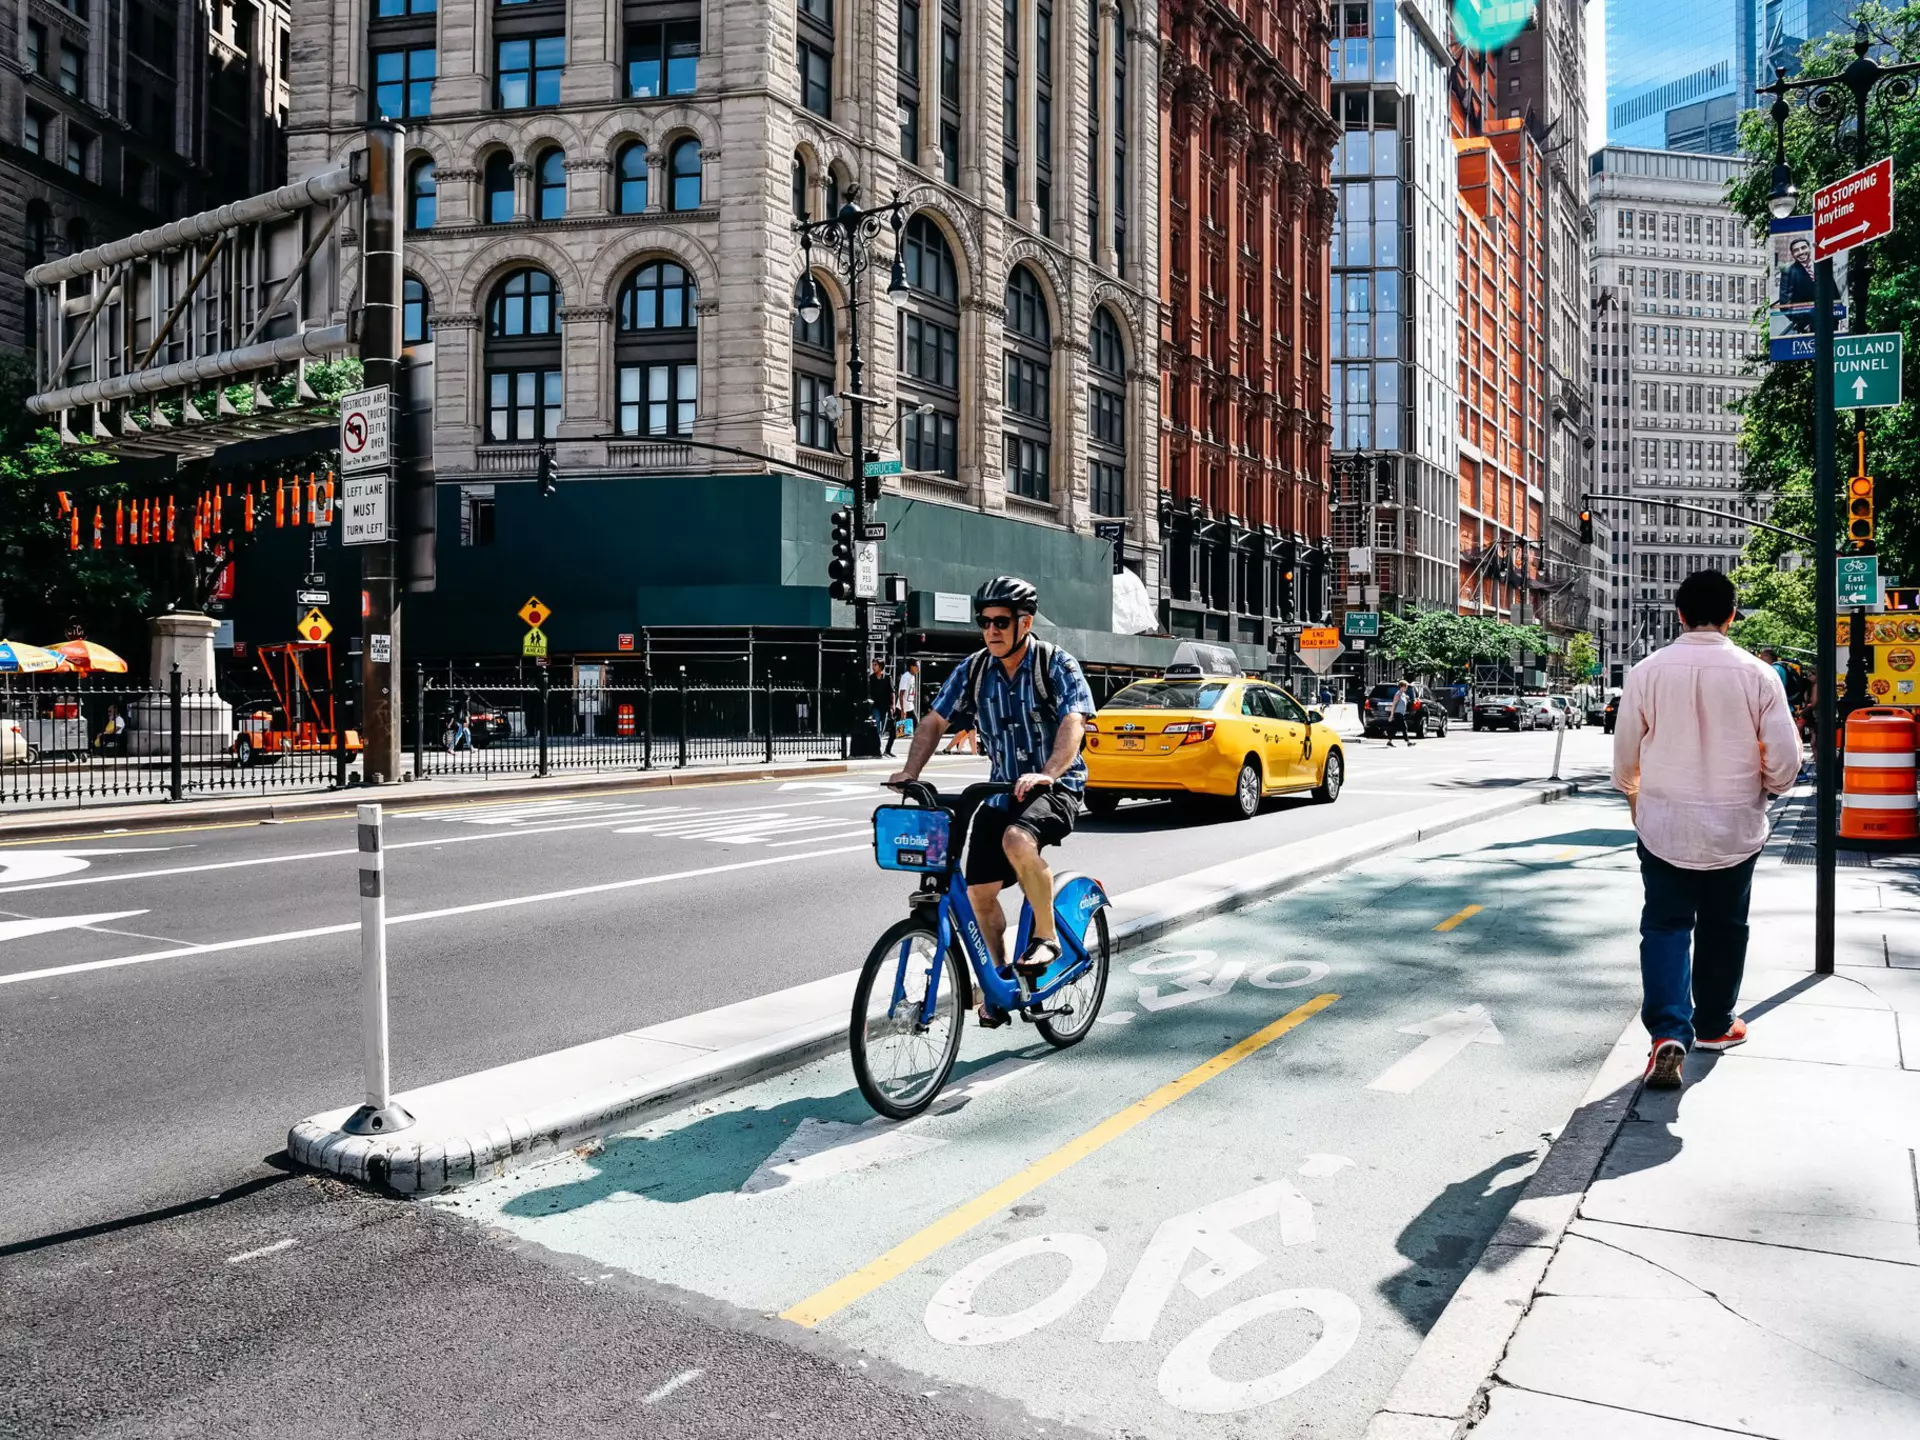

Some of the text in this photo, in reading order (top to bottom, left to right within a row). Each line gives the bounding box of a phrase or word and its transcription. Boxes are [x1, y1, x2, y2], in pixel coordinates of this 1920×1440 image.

[1817, 173, 1877, 211] NO STOPPING
[1817, 202, 1855, 226] Anytime
[1833, 342, 1895, 357] OLLAND
[1834, 358, 1889, 373] TUNNEL
[343, 392, 386, 411] RESTRICTED AREA
[367, 406, 386, 420] TRUCKS
[368, 424, 375, 435] 33
[376, 422, 381, 434] FT
[371, 437, 384, 449] OVER
[864, 463, 893, 475] SPRUCE
[346, 484, 383, 498] LEFT LANE
[353, 503, 376, 517] MUST
[346, 522, 383, 536] TURN LEFT
[1845, 583, 1867, 591] River
